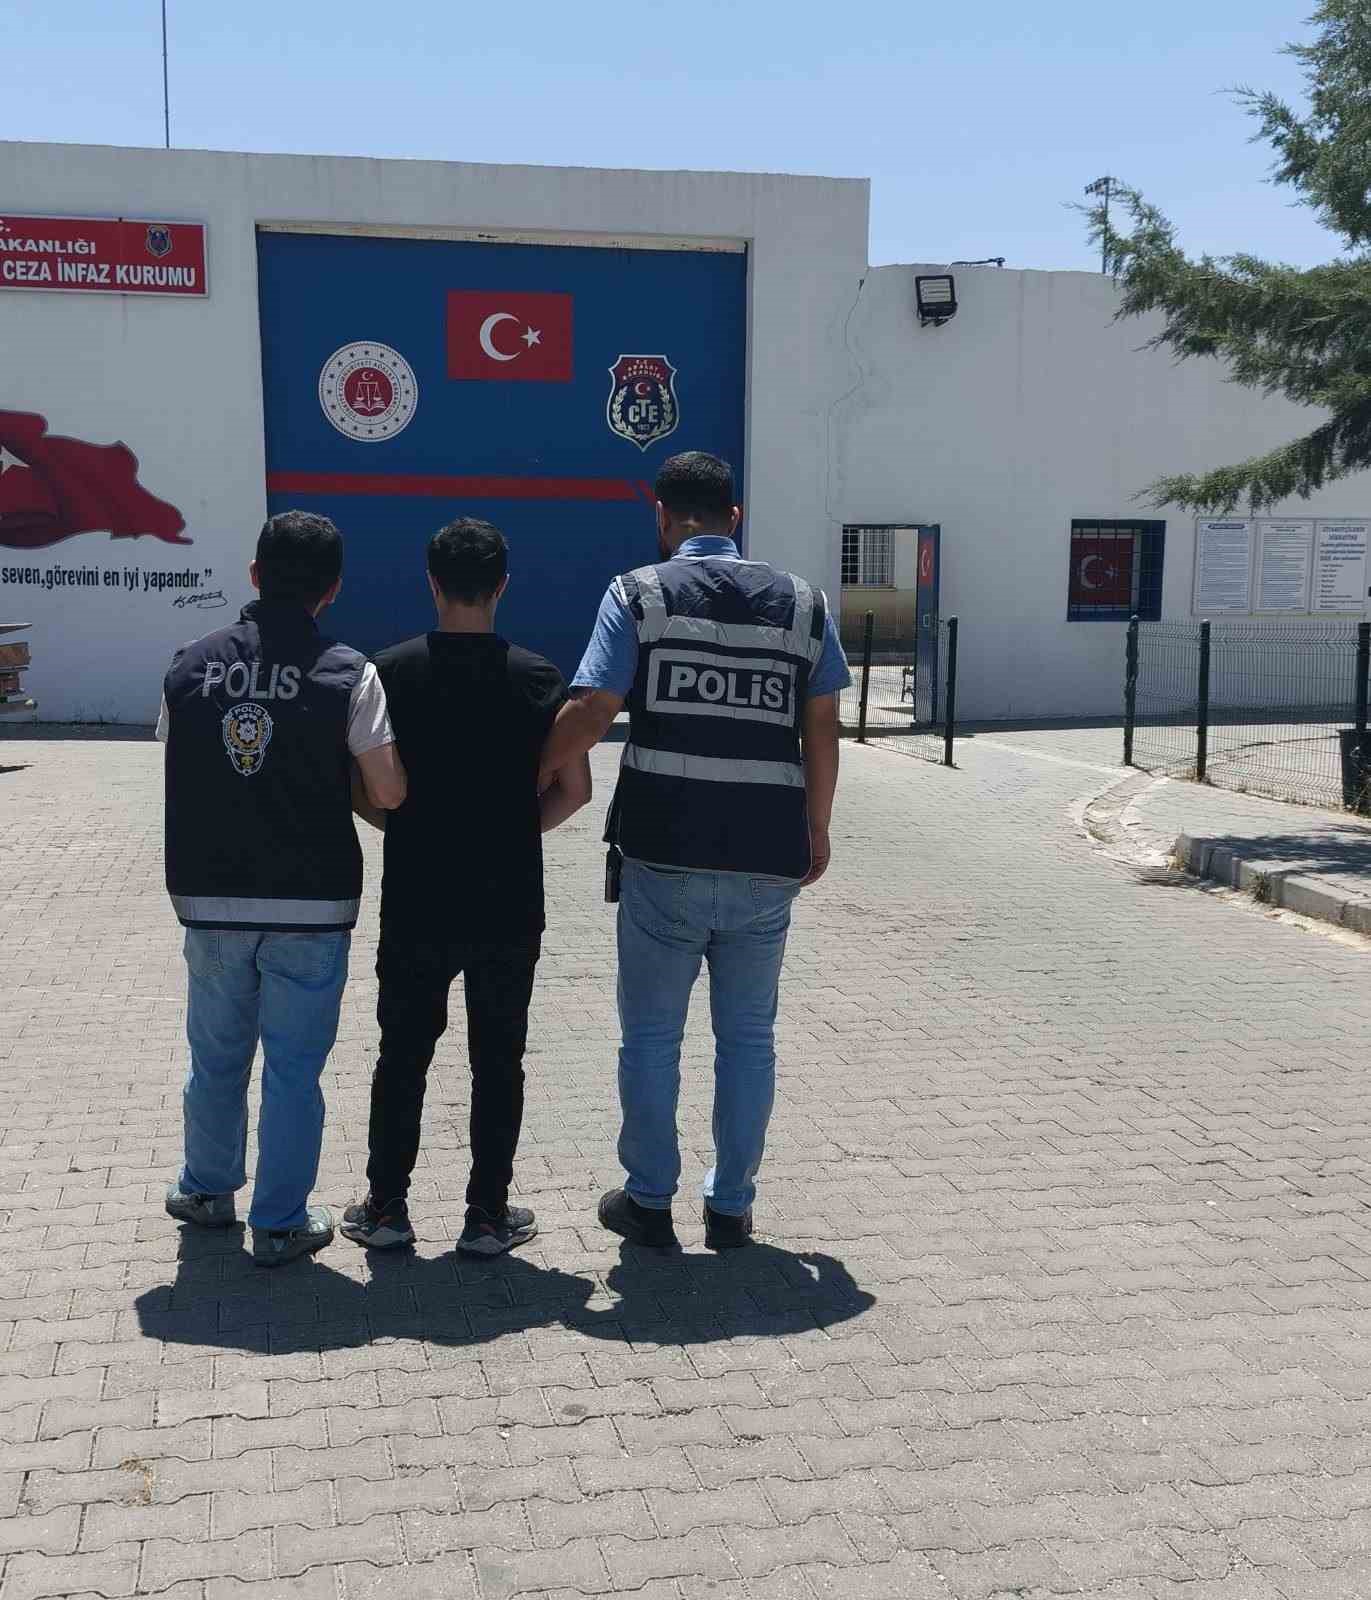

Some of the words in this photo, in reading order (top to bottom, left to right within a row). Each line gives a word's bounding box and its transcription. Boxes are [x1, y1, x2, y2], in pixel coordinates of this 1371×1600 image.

[3, 260, 52, 281] CEZA
[58, 258, 111, 284] İNFAZ
[116, 264, 196, 287] KURUMU
[104, 570, 120, 586] en
[124, 567, 140, 591] iyi
